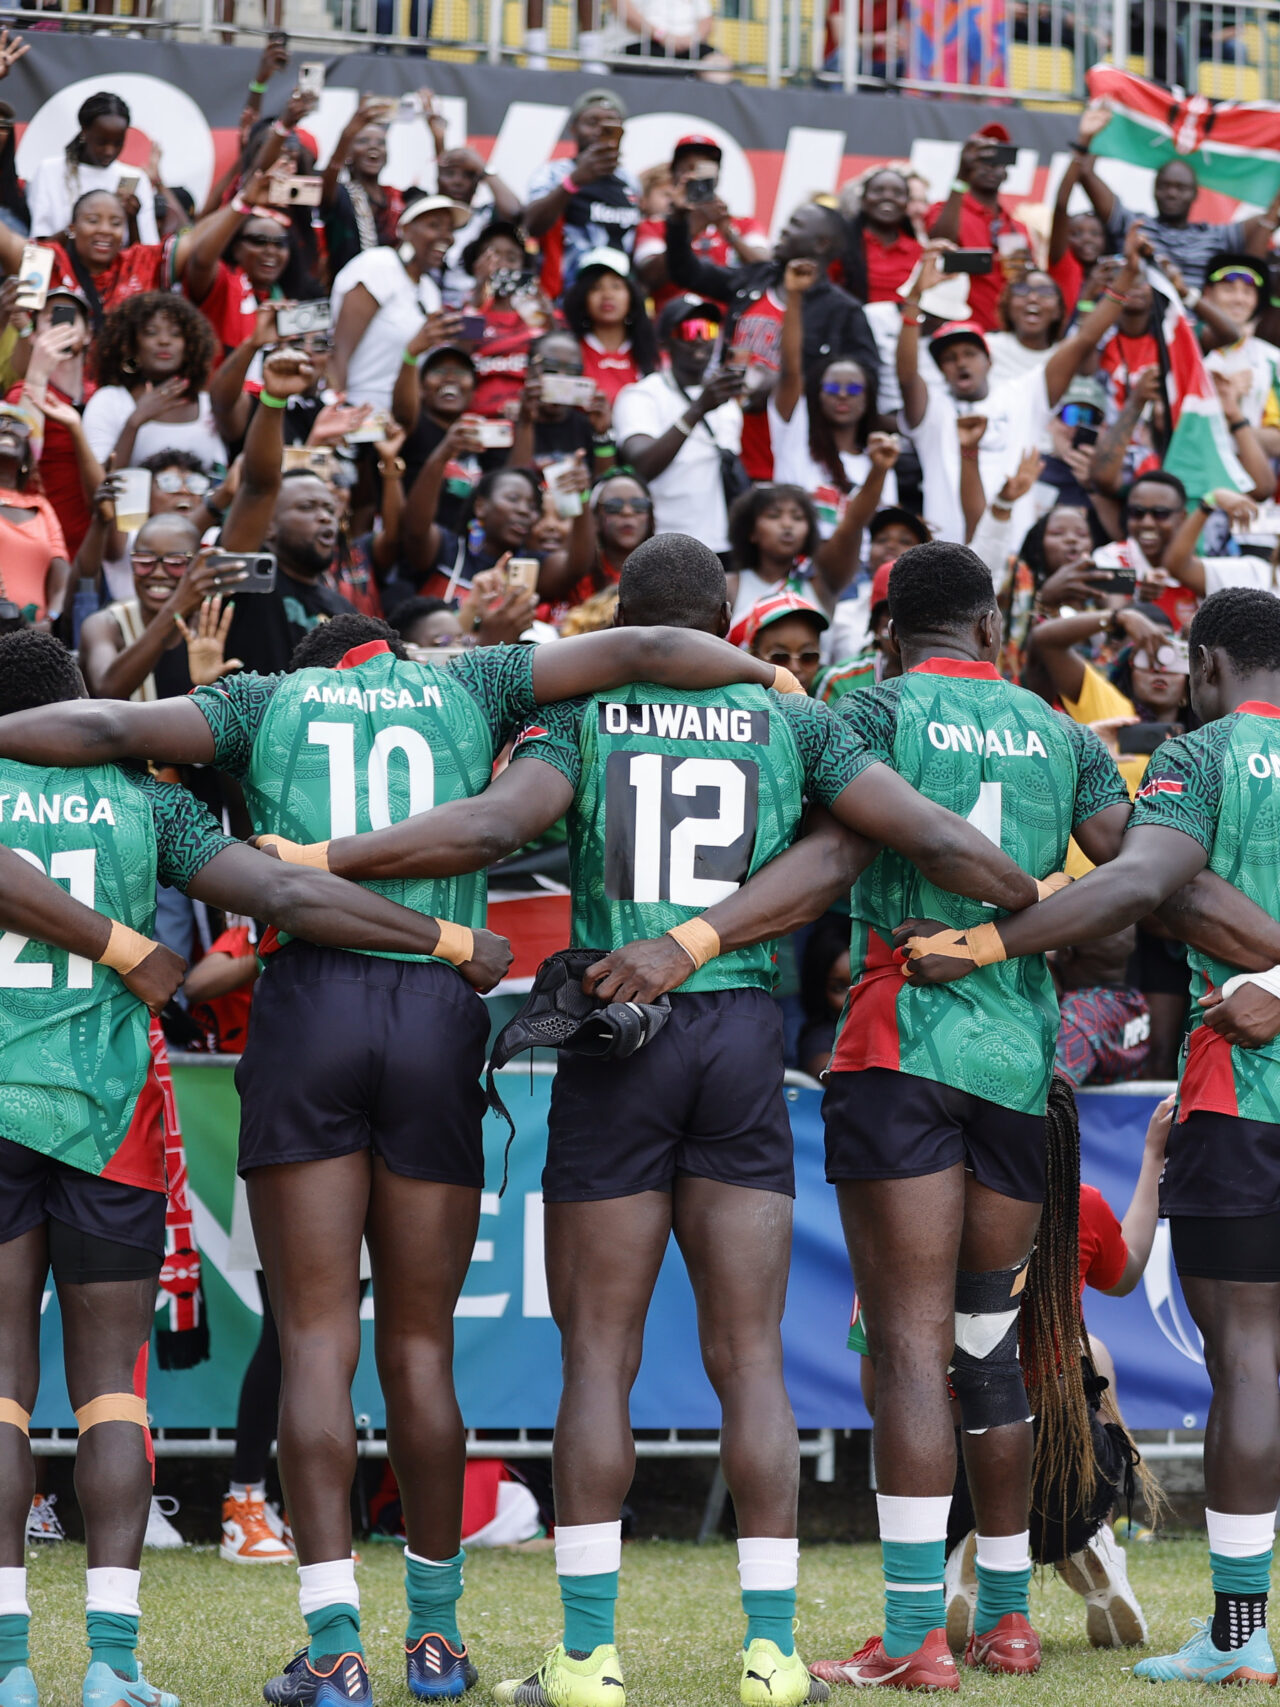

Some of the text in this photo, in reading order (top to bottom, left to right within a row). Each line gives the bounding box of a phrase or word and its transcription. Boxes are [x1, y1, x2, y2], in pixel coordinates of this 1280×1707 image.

[605, 703, 752, 742] OJWANG
[928, 721, 1048, 758] ONYALA
[308, 721, 436, 841] 10
[629, 753, 747, 907] 12
